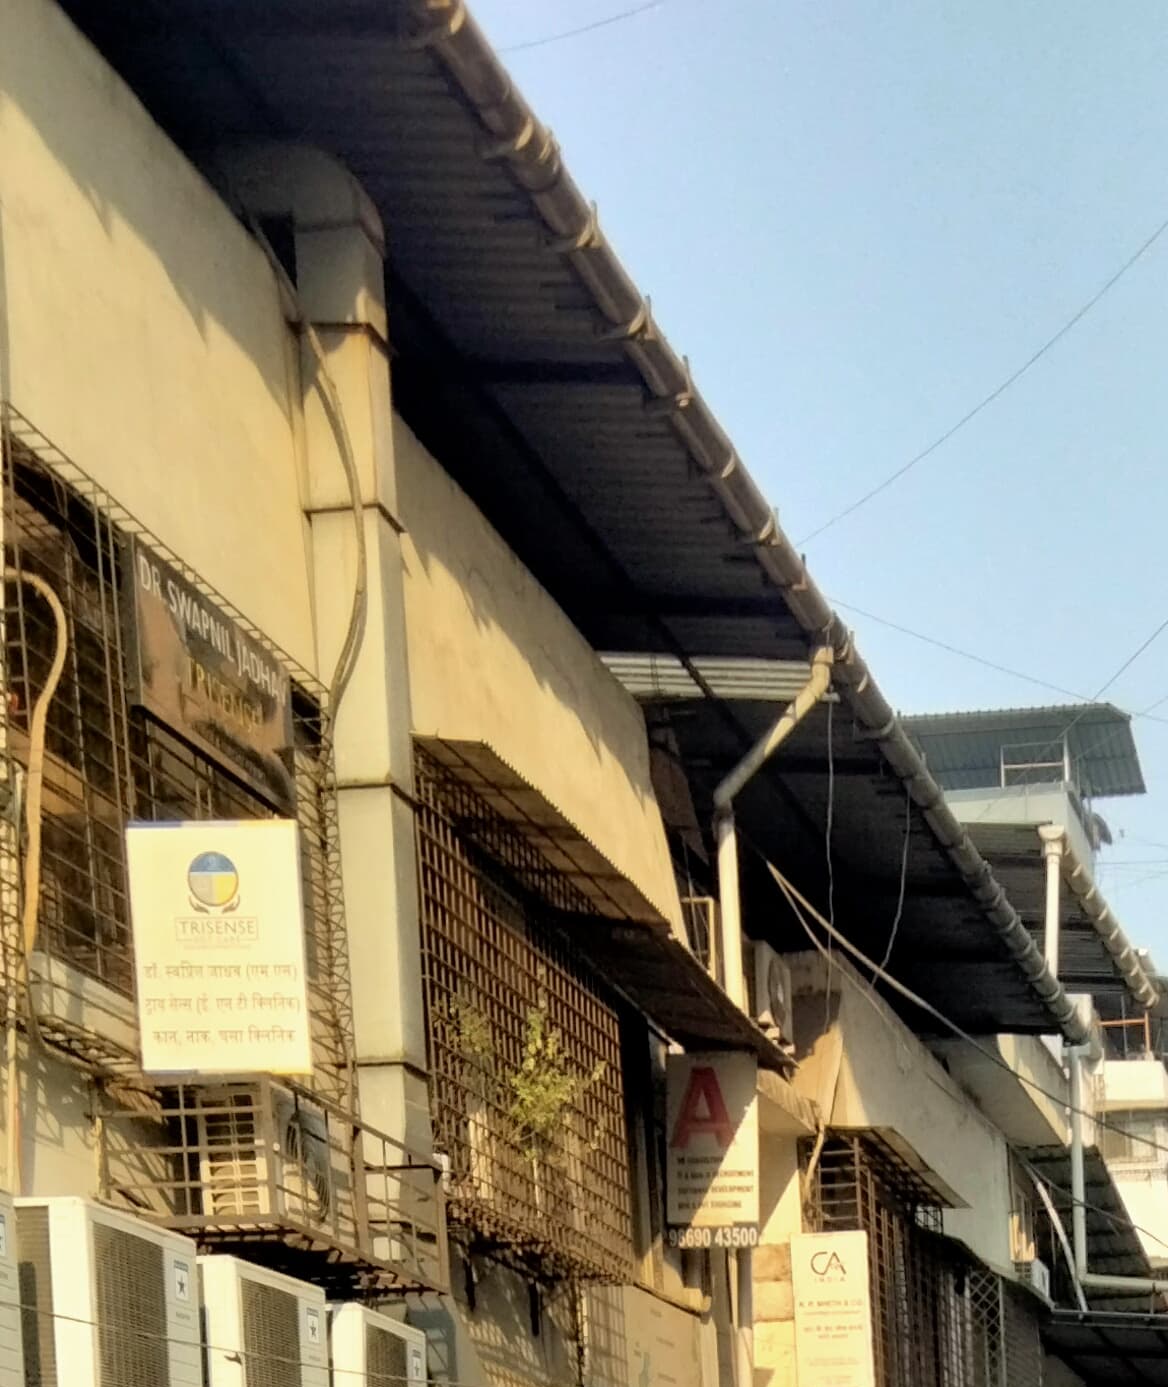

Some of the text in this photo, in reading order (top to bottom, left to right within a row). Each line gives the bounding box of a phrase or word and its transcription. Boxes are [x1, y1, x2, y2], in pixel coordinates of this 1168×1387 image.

[168, 579, 235, 664] SWAPNIL
[179, 920, 255, 935] TRISENSE
[669, 1225, 758, 1249] 98690 43500
